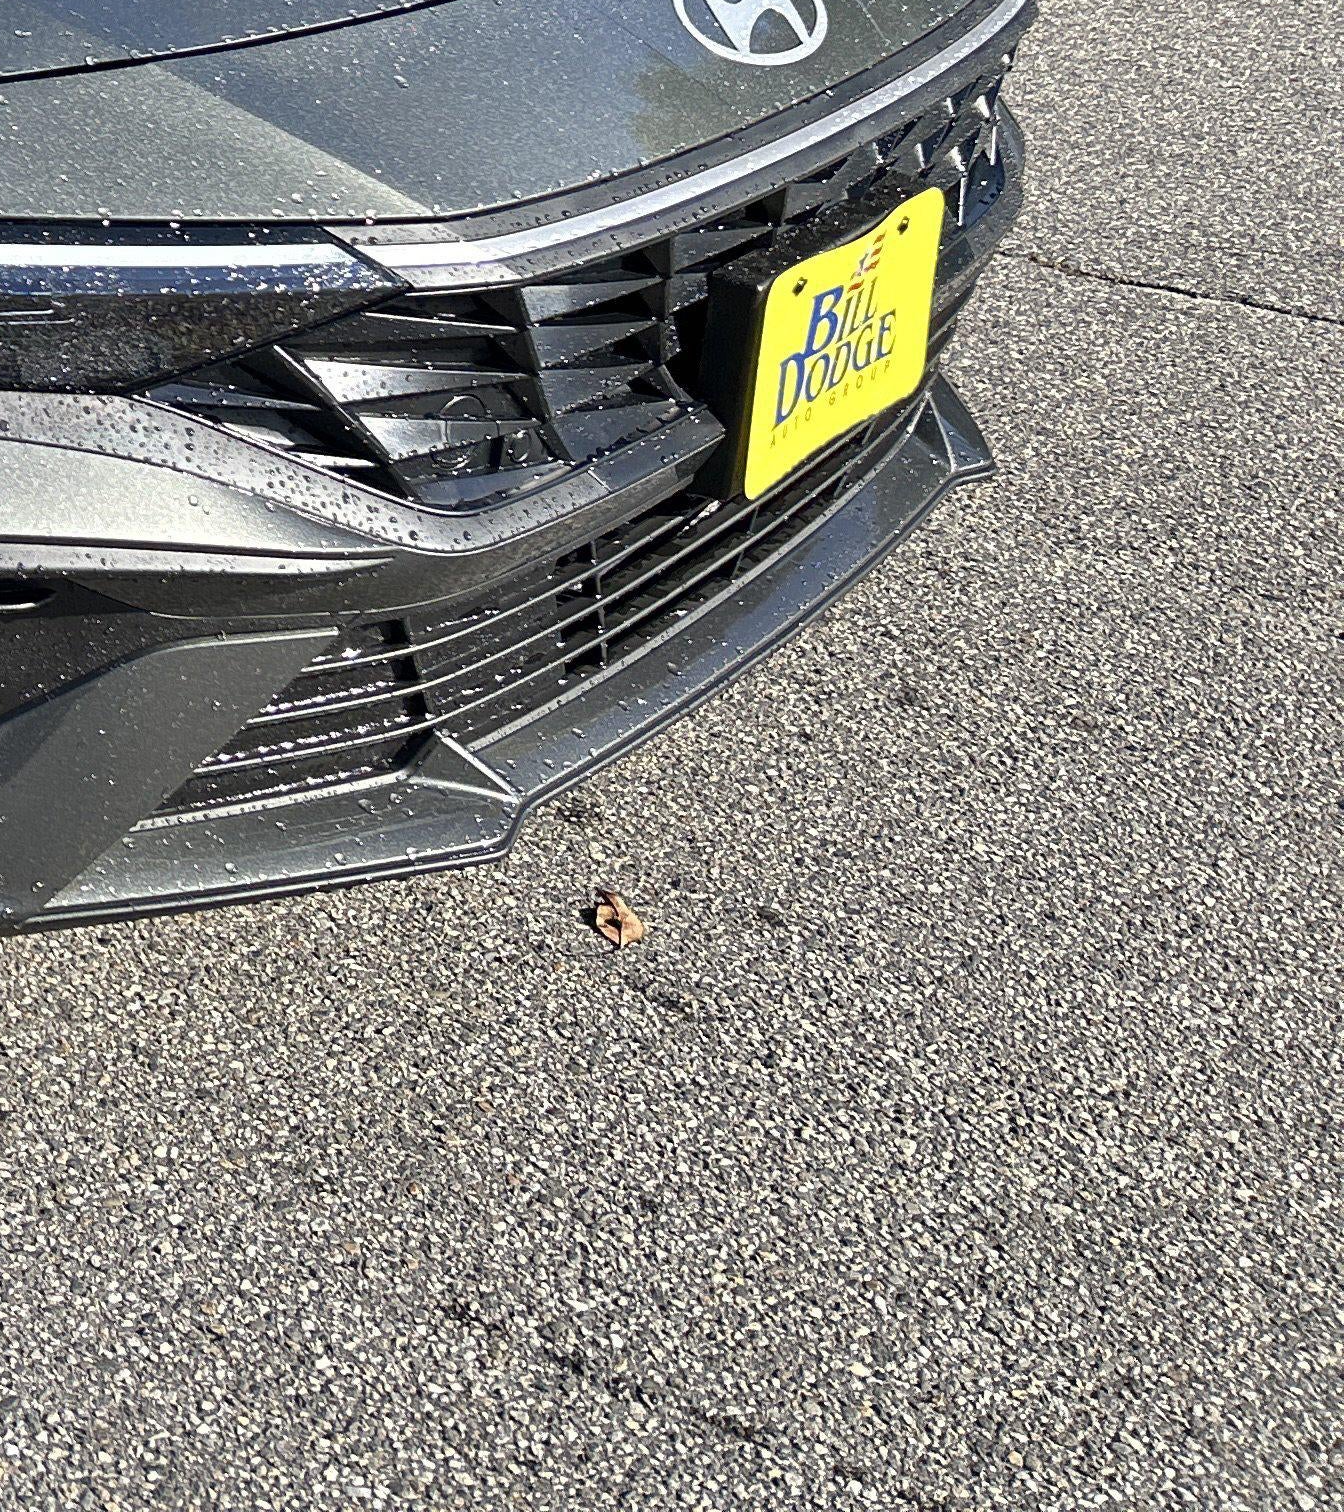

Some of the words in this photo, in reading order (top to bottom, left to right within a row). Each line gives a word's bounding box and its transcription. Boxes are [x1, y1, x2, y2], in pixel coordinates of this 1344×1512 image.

[769, 406, 812, 449] AUTO
[828, 359, 892, 406] GROUP
[771, 307, 897, 432] DODGE
